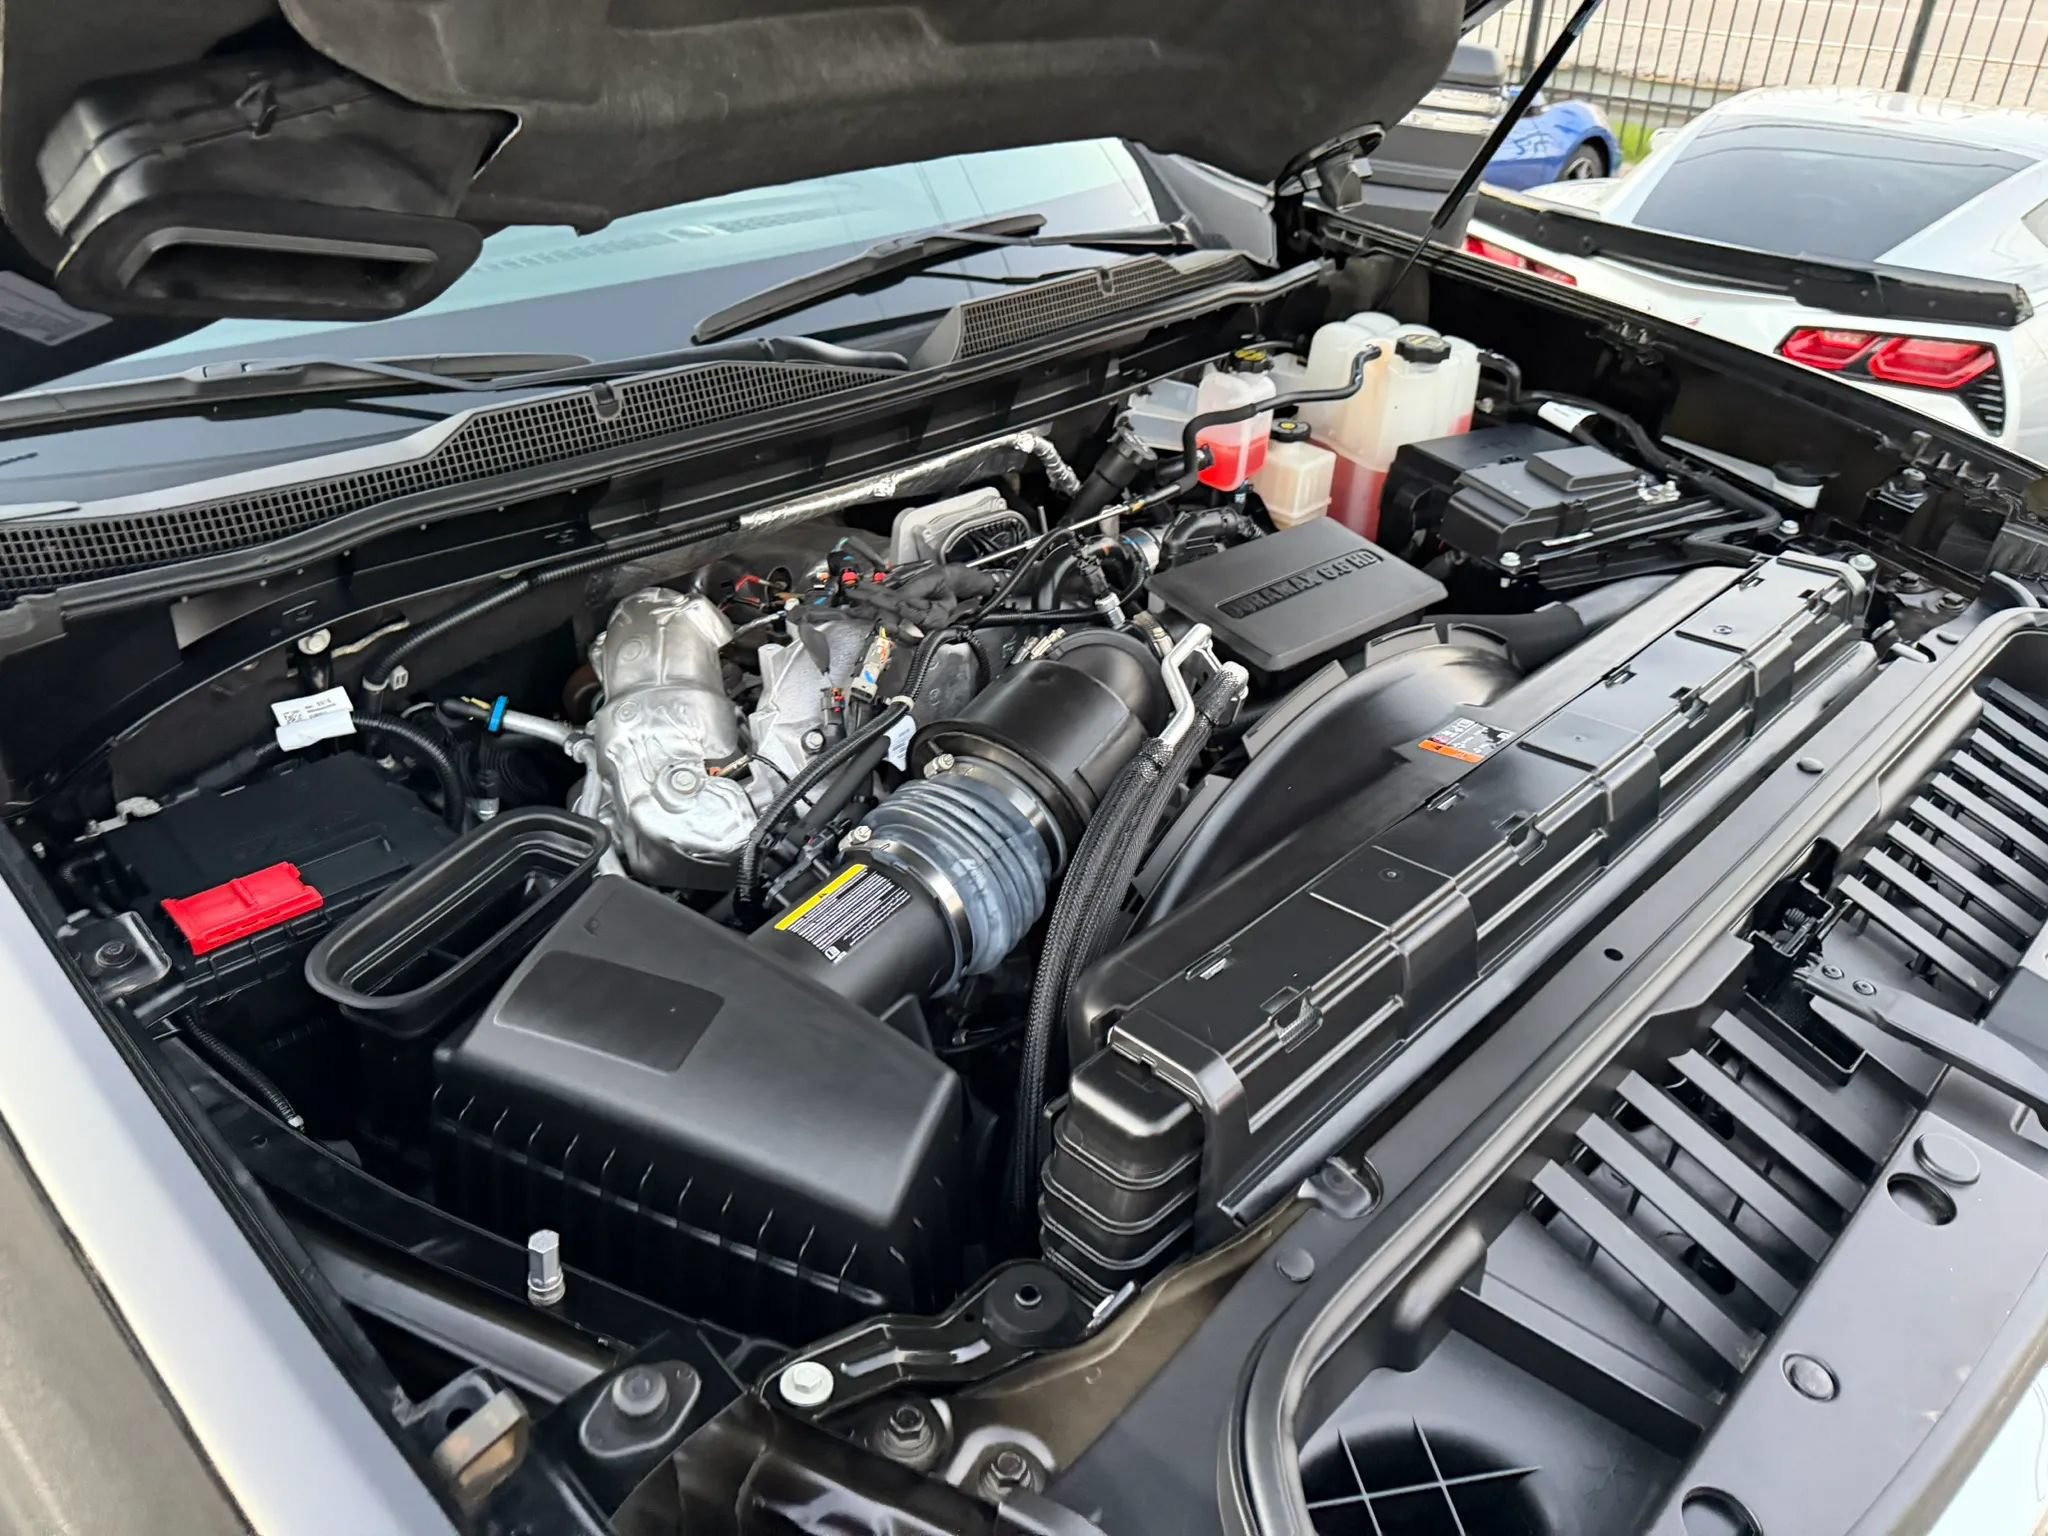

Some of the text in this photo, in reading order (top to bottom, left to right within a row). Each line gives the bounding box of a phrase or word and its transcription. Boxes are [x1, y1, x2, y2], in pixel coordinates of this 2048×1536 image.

[1225, 550, 1377, 617] DURAMAX 6.6 HD
